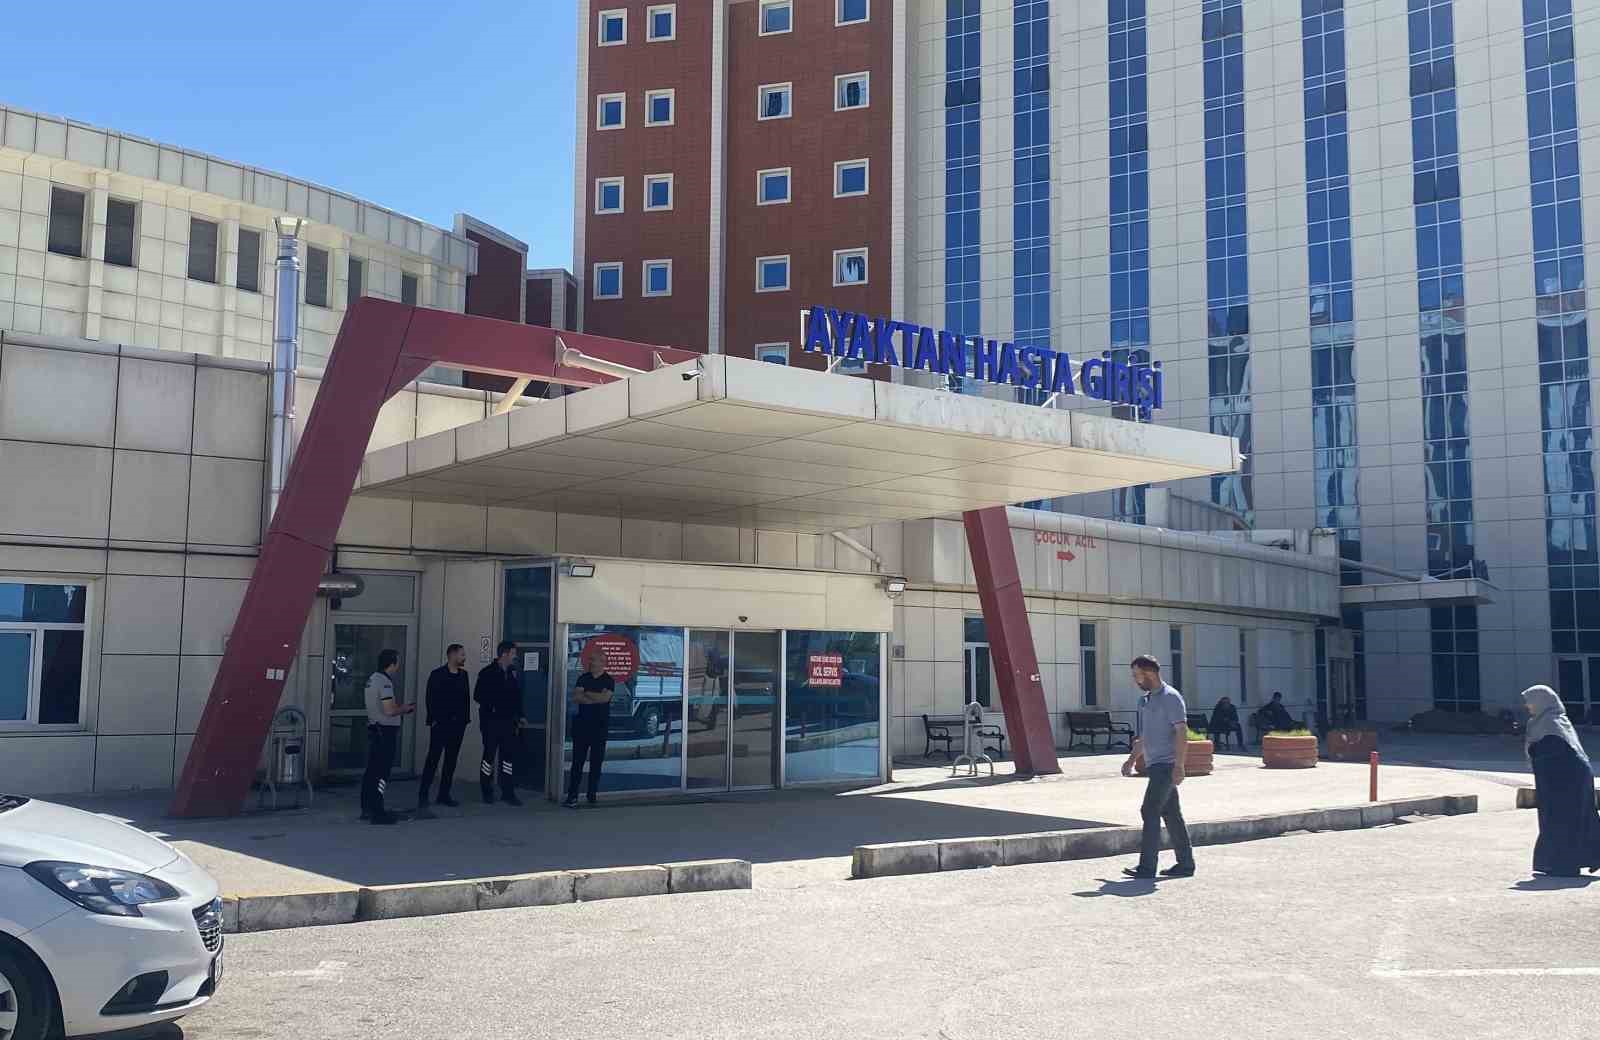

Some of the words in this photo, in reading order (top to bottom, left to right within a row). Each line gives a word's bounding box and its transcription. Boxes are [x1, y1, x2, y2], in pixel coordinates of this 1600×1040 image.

[804, 305, 966, 377] AYAKTAN
[973, 335, 1075, 395] HASTA
[1081, 350, 1162, 423] GİRİŞİ
